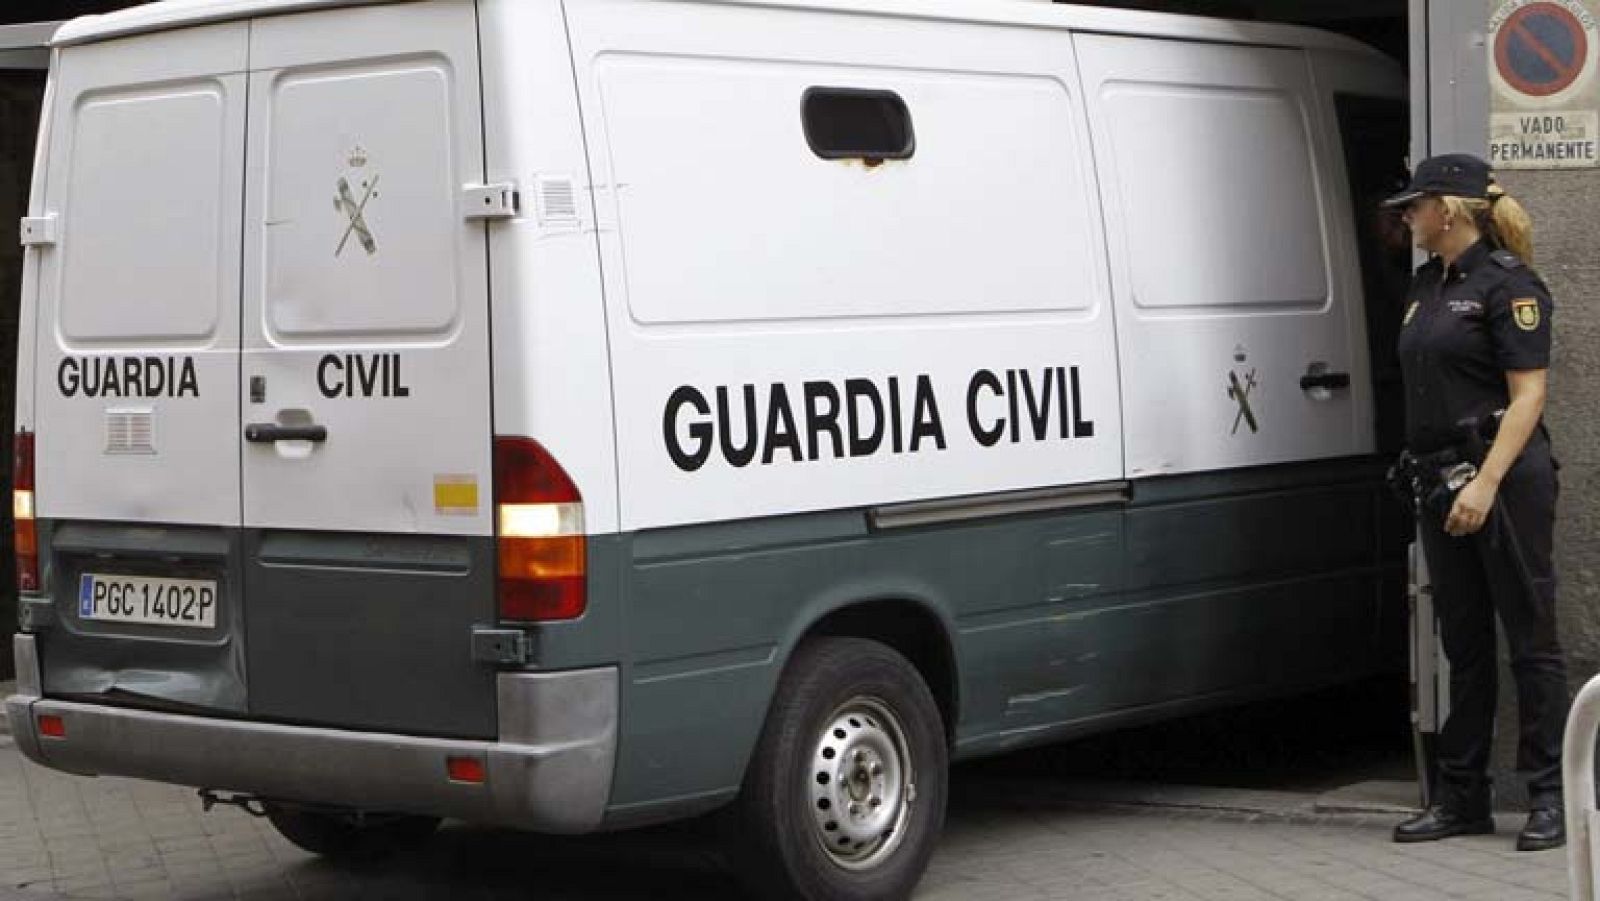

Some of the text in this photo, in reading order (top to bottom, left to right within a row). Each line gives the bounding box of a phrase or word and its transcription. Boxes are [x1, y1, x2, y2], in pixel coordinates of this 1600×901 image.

[1520, 116, 1564, 134] VADO
[1491, 142, 1594, 160] PERMANENTE
[58, 353, 409, 398] GUARDIA CIVIL
[663, 366, 1094, 472] GUARDIA CIVIL
[94, 581, 135, 615] PGC
